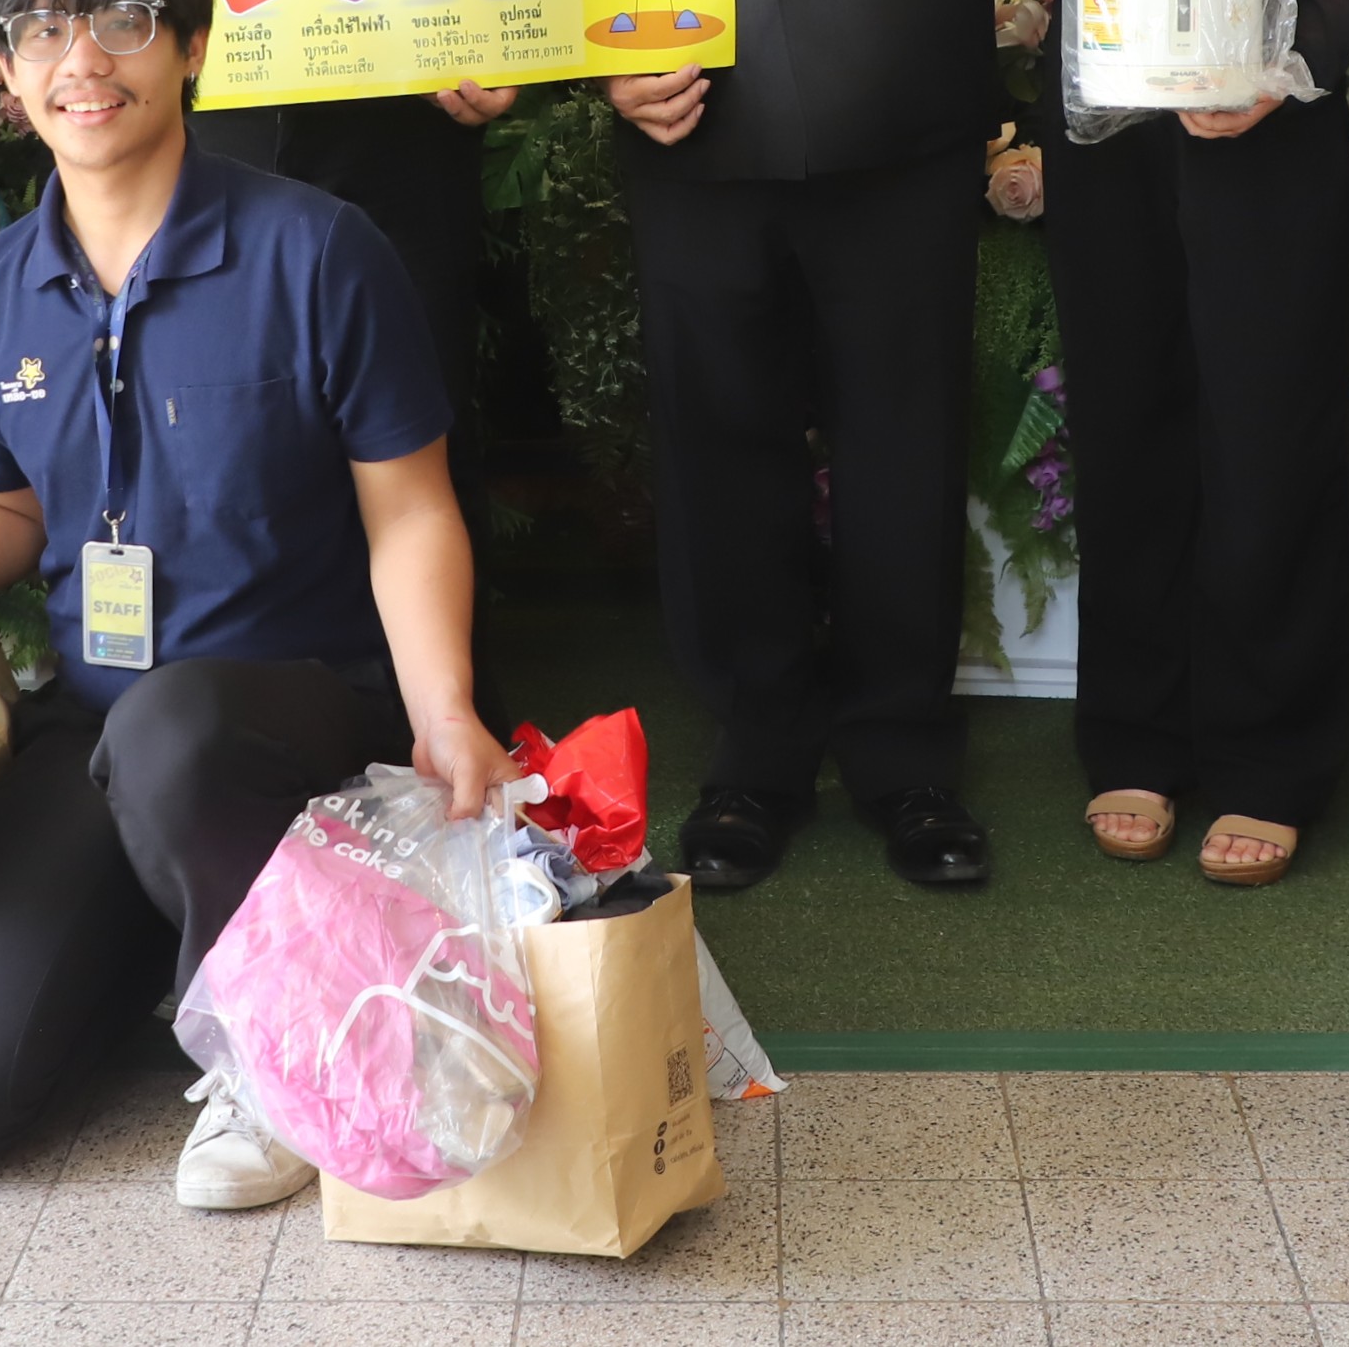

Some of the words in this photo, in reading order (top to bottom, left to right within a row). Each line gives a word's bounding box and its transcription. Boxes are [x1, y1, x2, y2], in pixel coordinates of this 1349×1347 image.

[411, 8, 461, 28] ของเล่น
[499, 0, 543, 25] อุปกรณ์
[224, 23, 272, 43] หนังสือ
[301, 13, 391, 37] เครื่องใช้ไฟฟ้า
[501, 23, 548, 42] การเรียน
[413, 29, 490, 49] ของใช้จิปาถะ
[226, 43, 273, 64] กระเป๋า
[303, 40, 349, 61] ทุกชนิด
[227, 64, 270, 84] รองเท้า
[93, 600, 142, 617] STAFF
[333, 842, 403, 879] cake
